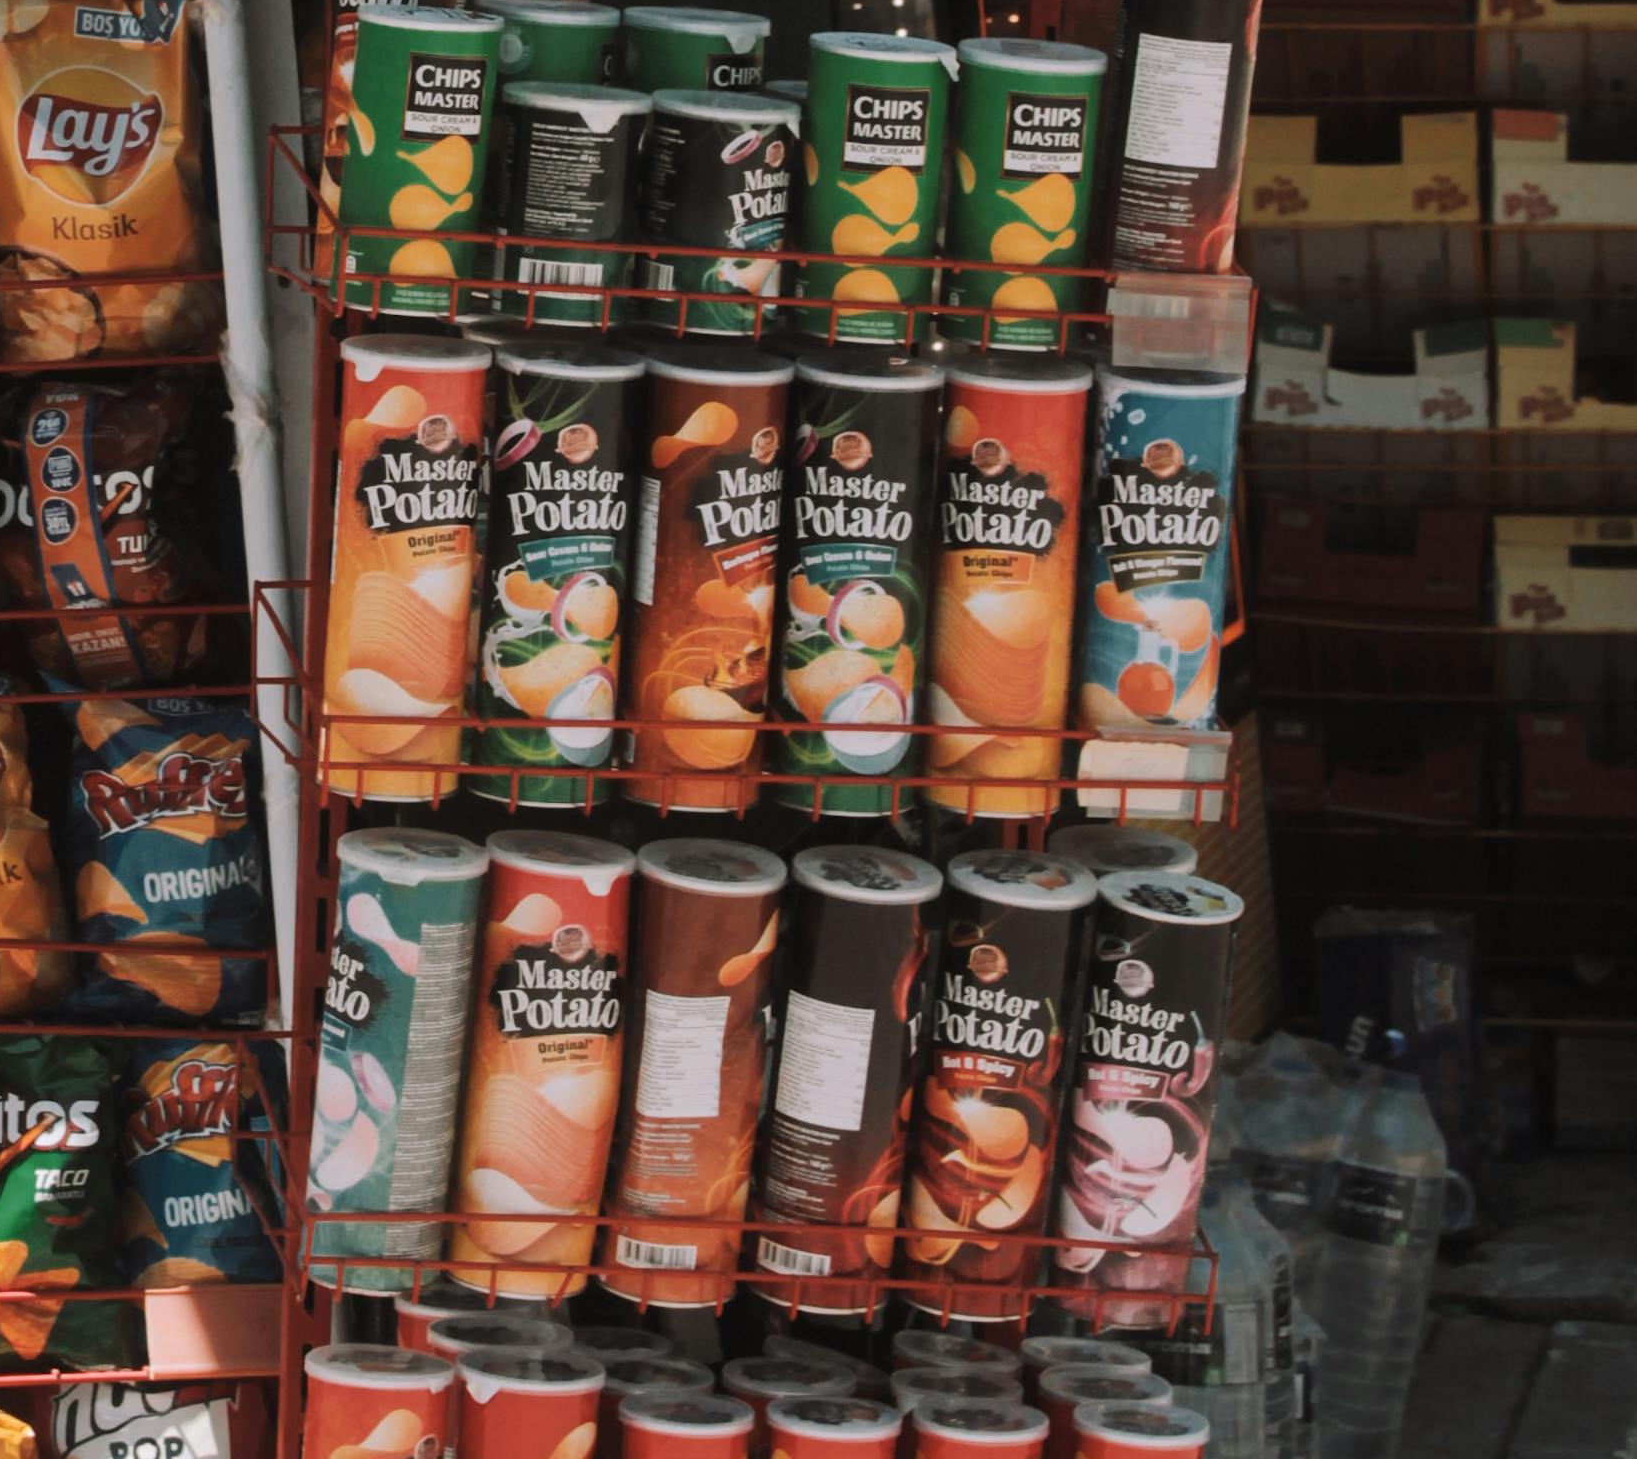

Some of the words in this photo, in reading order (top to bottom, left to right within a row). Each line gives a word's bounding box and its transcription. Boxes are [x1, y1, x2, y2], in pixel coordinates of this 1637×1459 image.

[82, 12, 115, 40] BOŞ
[414, 65, 481, 88] CHIPS
[414, 90, 479, 109] MASTER
[853, 96, 924, 121] CHIPS
[1013, 104, 1083, 128] CHIPS
[27, 97, 155, 176] Lay's
[853, 122, 922, 141] MASTER
[1013, 130, 1080, 149] MASTER
[51, 216, 138, 242] Klasik
[383, 452, 477, 484] Master
[524, 460, 625, 494] Master
[805, 466, 907, 504] Master
[364, 481, 479, 530] Potato
[949, 473, 1046, 511] Master
[1113, 474, 1215, 509] Master
[508, 492, 628, 536] Potato
[795, 497, 913, 541] Potato
[940, 503, 1052, 549] Potato
[1099, 503, 1221, 547] Potato
[407, 532, 457, 549] Original
[963, 555, 1013, 569] Original
[145, 856, 257, 903] ORIGINAL
[516, 958, 617, 992] Master
[498, 989, 620, 1033] Potato
[943, 972, 1039, 1021] Master
[1090, 985, 1185, 1033] Master
[933, 1001, 1044, 1058] Potato
[1082, 1013, 1190, 1070] Potato
[538, 1039, 591, 1055] Original
[977, 1058, 1015, 1077] Spicy
[34, 1169, 89, 1188] TACO
